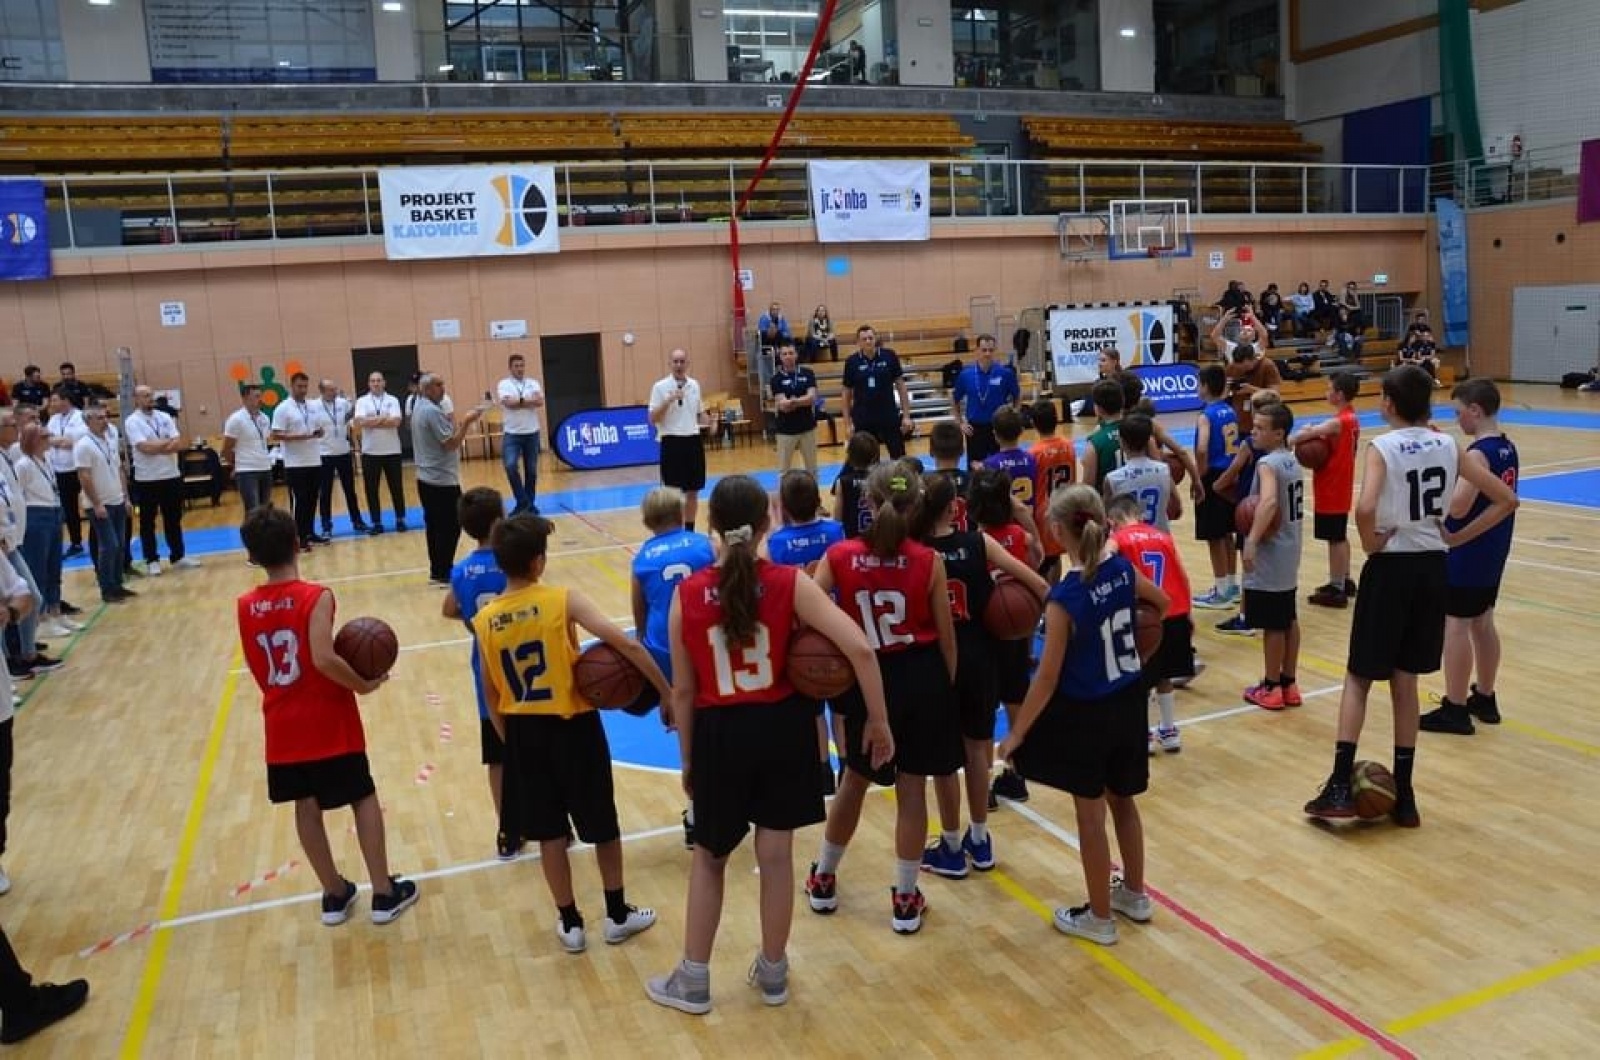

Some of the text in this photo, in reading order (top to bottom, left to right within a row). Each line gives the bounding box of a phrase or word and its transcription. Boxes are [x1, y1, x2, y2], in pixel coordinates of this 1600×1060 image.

[399, 192, 476, 207] PROJEKT
[410, 208, 477, 222] BASKET
[845, 188, 867, 210] nba
[393, 222, 479, 238] KATOWICE
[1064, 327, 1117, 340] PROJEKT
[1071, 340, 1118, 353] BASKET
[592, 422, 619, 444] nba
[1287, 479, 1304, 522] 12
[1406, 466, 1447, 521] 12
[1141, 550, 1165, 588] 7
[854, 589, 915, 650] 12
[255, 629, 301, 686] 13
[706, 621, 774, 696] 13
[1099, 608, 1142, 682] 13
[499, 640, 553, 702] 12
